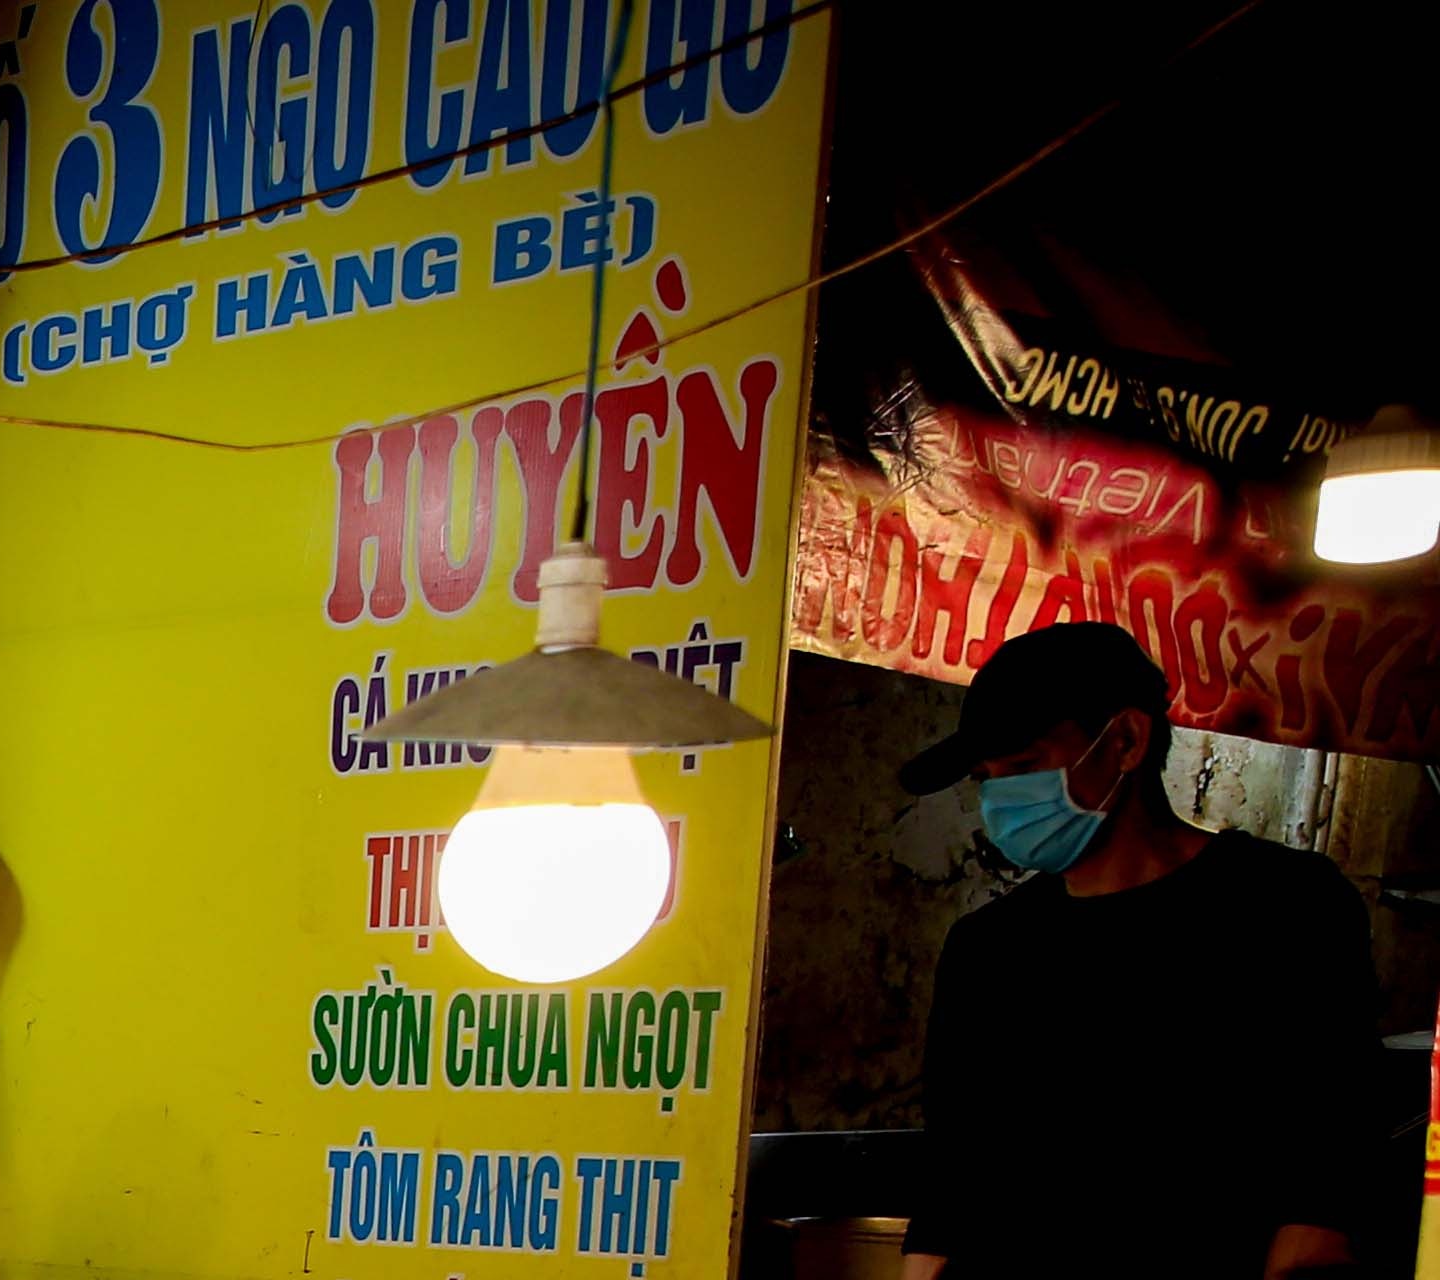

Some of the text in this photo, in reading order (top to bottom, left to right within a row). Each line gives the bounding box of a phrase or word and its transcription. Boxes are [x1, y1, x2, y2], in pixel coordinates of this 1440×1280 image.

[53, 0, 160, 264] 3
[215, 238, 458, 339] HÀNG
[326, 261, 778, 625] HUYỀN
[311, 969, 723, 1113] SƯỜN CHUA NGỌT
[327, 1131, 682, 1279] TÔM RANG THỊT
